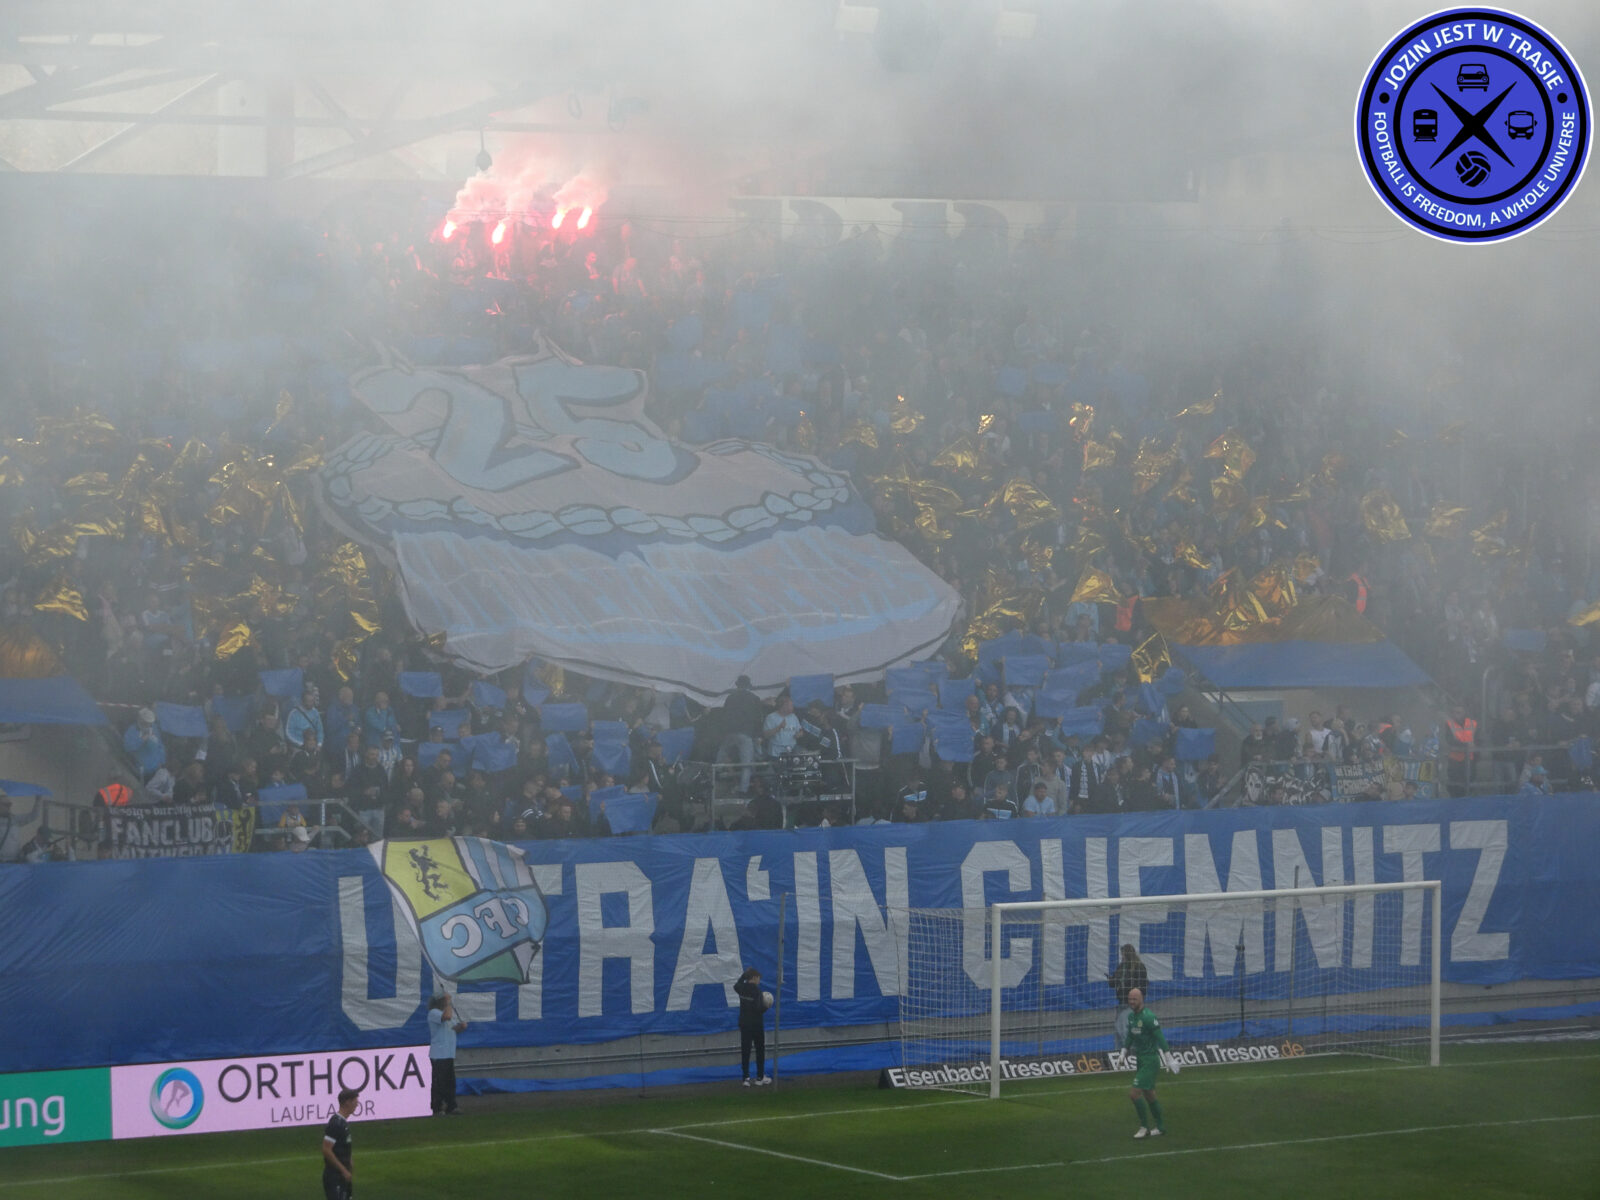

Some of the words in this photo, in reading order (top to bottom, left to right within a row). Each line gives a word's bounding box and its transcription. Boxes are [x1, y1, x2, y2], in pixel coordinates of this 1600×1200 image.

[353, 360, 702, 494] 25
[110, 815, 215, 847] FANCLUB
[960, 819, 1510, 990] CHEMNITZ
[887, 1061, 992, 1088] Eisenbach
[1107, 1046, 1209, 1072] Eisach
[217, 1052, 426, 1103] ORTHOKA
[271, 1100, 376, 1123] LAUFLAOR
